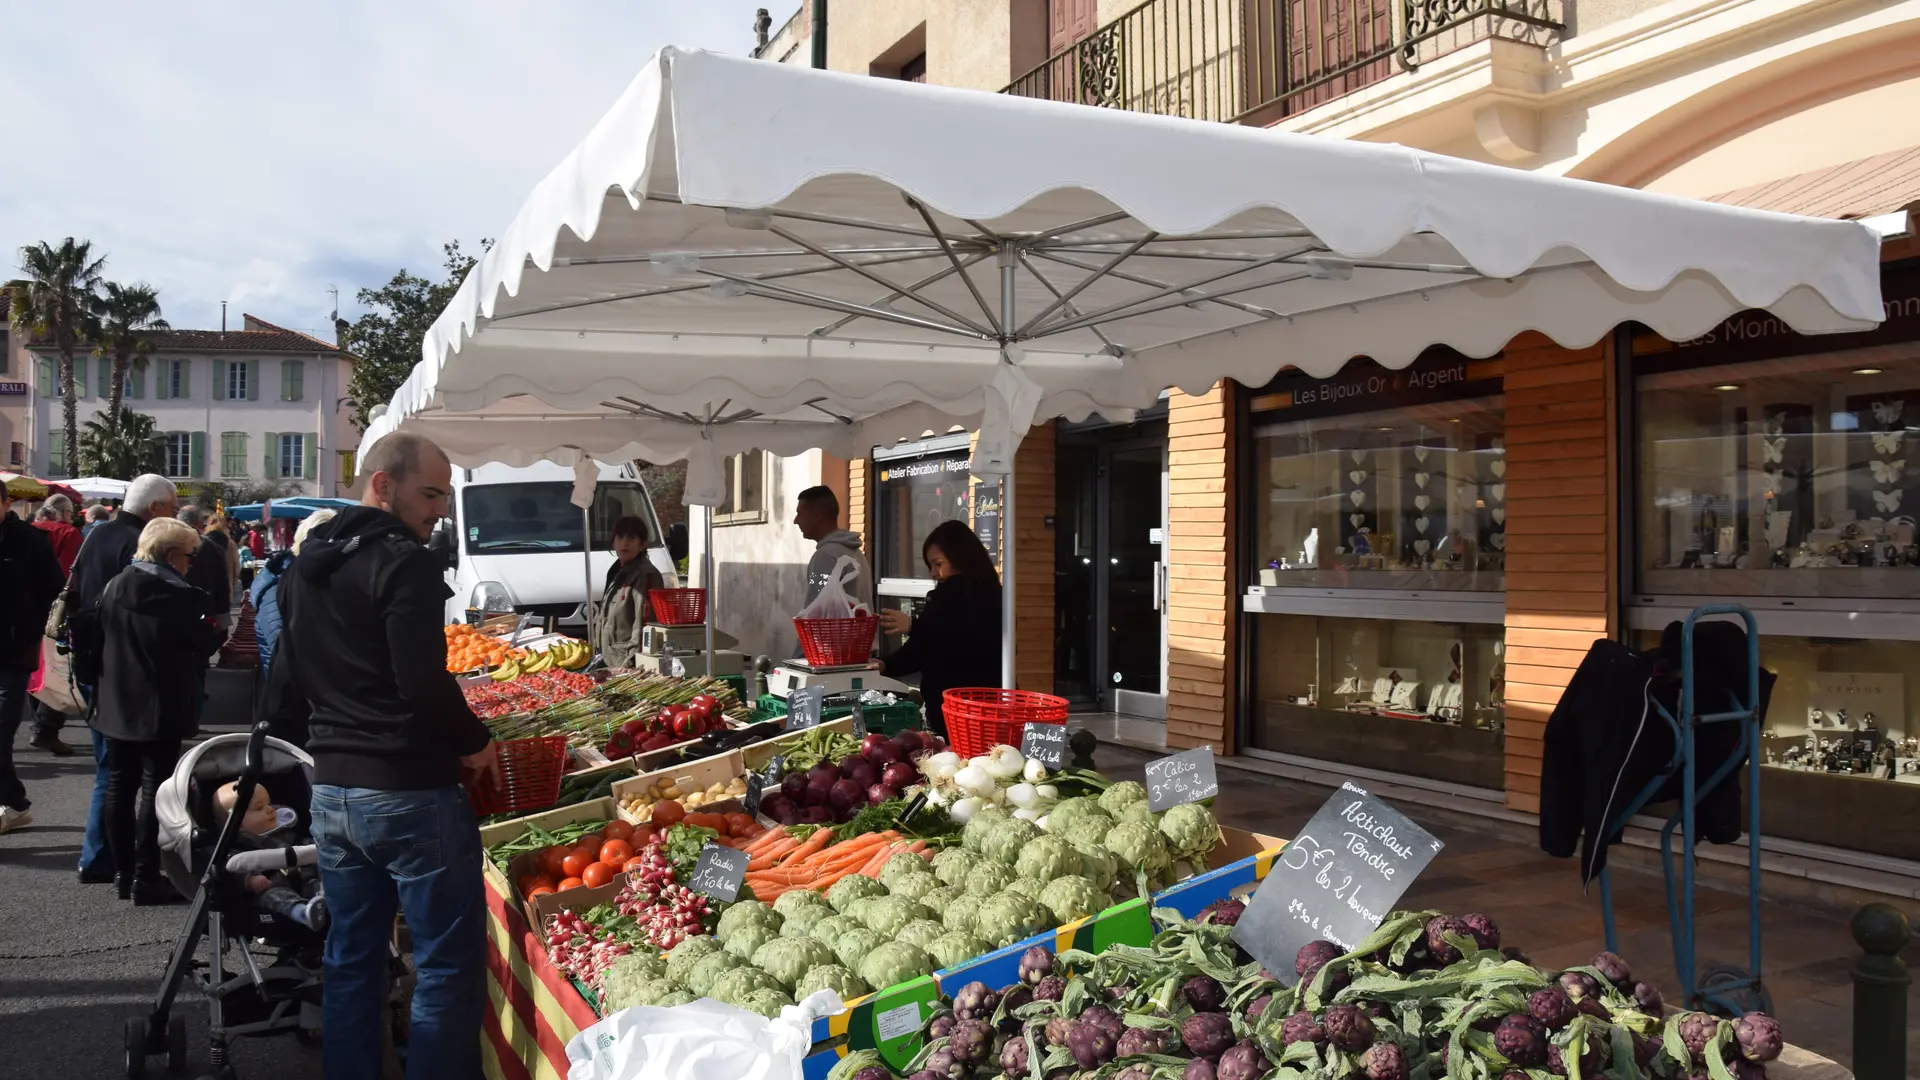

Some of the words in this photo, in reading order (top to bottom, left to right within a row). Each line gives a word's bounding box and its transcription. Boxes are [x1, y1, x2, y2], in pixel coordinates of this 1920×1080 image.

[1725, 317, 1794, 342] Mont
[1294, 389, 1317, 404] Les
[1320, 382, 1364, 403] Bijoux
[1367, 376, 1386, 394] Or
[1408, 365, 1465, 389] Argent
[888, 468, 906, 479] Atelier
[906, 463, 939, 477] Fabrication
[1164, 761, 1196, 778] Calico
[1175, 778, 1188, 793] les
[1193, 773, 1201, 785] 2
[1343, 832, 1395, 881] Tendre
[1315, 861, 1334, 889] les
[1334, 875, 1353, 900] 2
